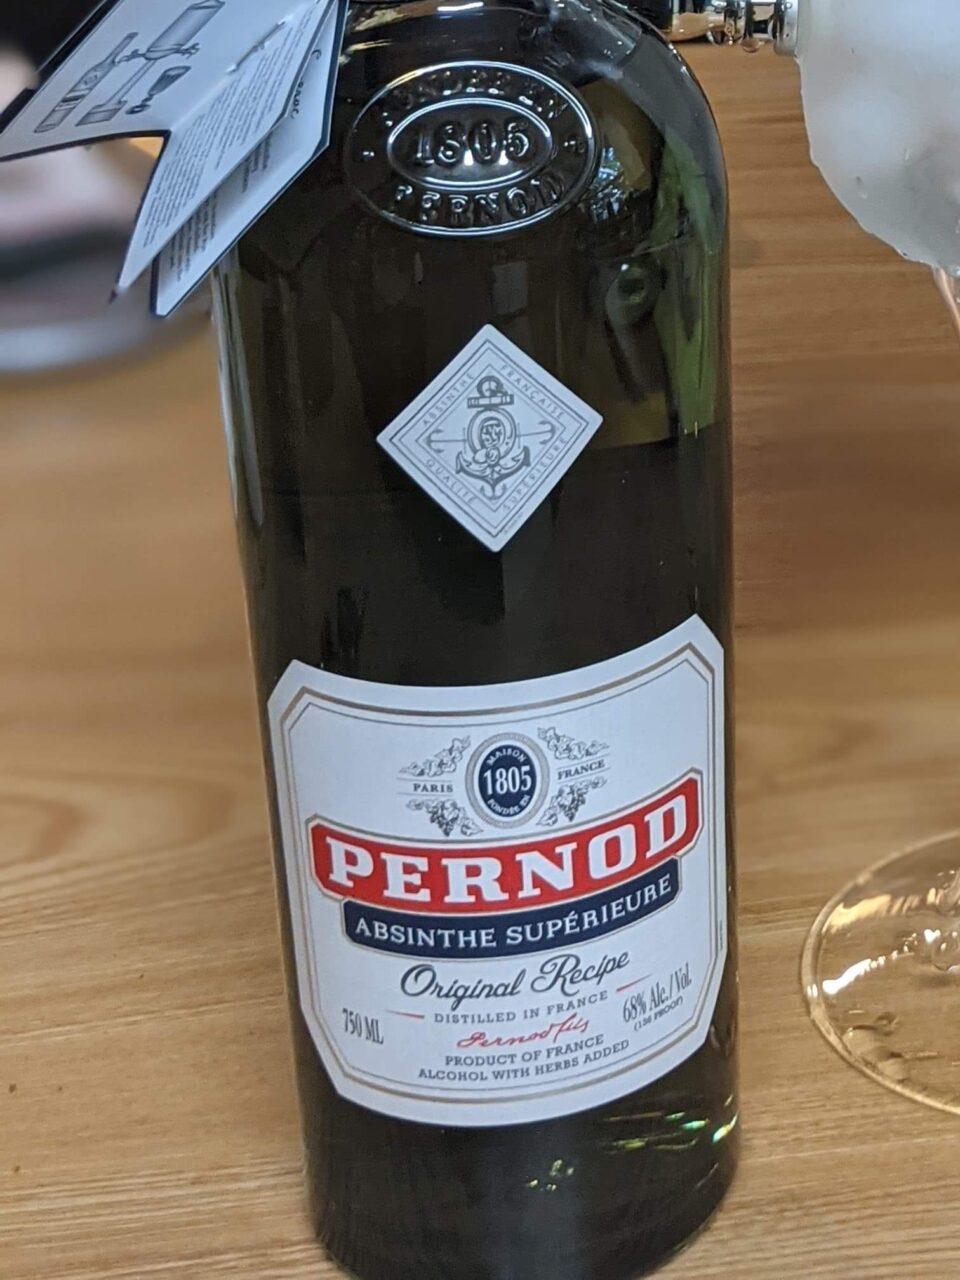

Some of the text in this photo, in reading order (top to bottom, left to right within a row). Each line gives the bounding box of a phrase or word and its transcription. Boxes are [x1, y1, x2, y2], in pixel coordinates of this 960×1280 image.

[412, 121, 530, 167] 1805
[422, 372, 476, 428] ABSINTHE
[501, 363, 565, 420] FRANÇAISE
[486, 748, 527, 766] MAISON
[557, 759, 605, 780] FRANCE
[413, 783, 453, 793] PARIS
[483, 765, 532, 795] 1805
[325, 794, 687, 903] PERNOD
[354, 873, 672, 950] ABSINTHE SUPÉRIEURE
[401, 951, 630, 1011] Original Recipe
[434, 990, 608, 1024] DISTILLED IN FRANCE
[623, 991, 647, 1022] 68%
[342, 1008, 384, 1045] 750 ML
[418, 1039, 629, 1081] ALCOHOL WITH HERBS ADDED
[445, 1034, 604, 1066] PRODUCT OF FRANCE
